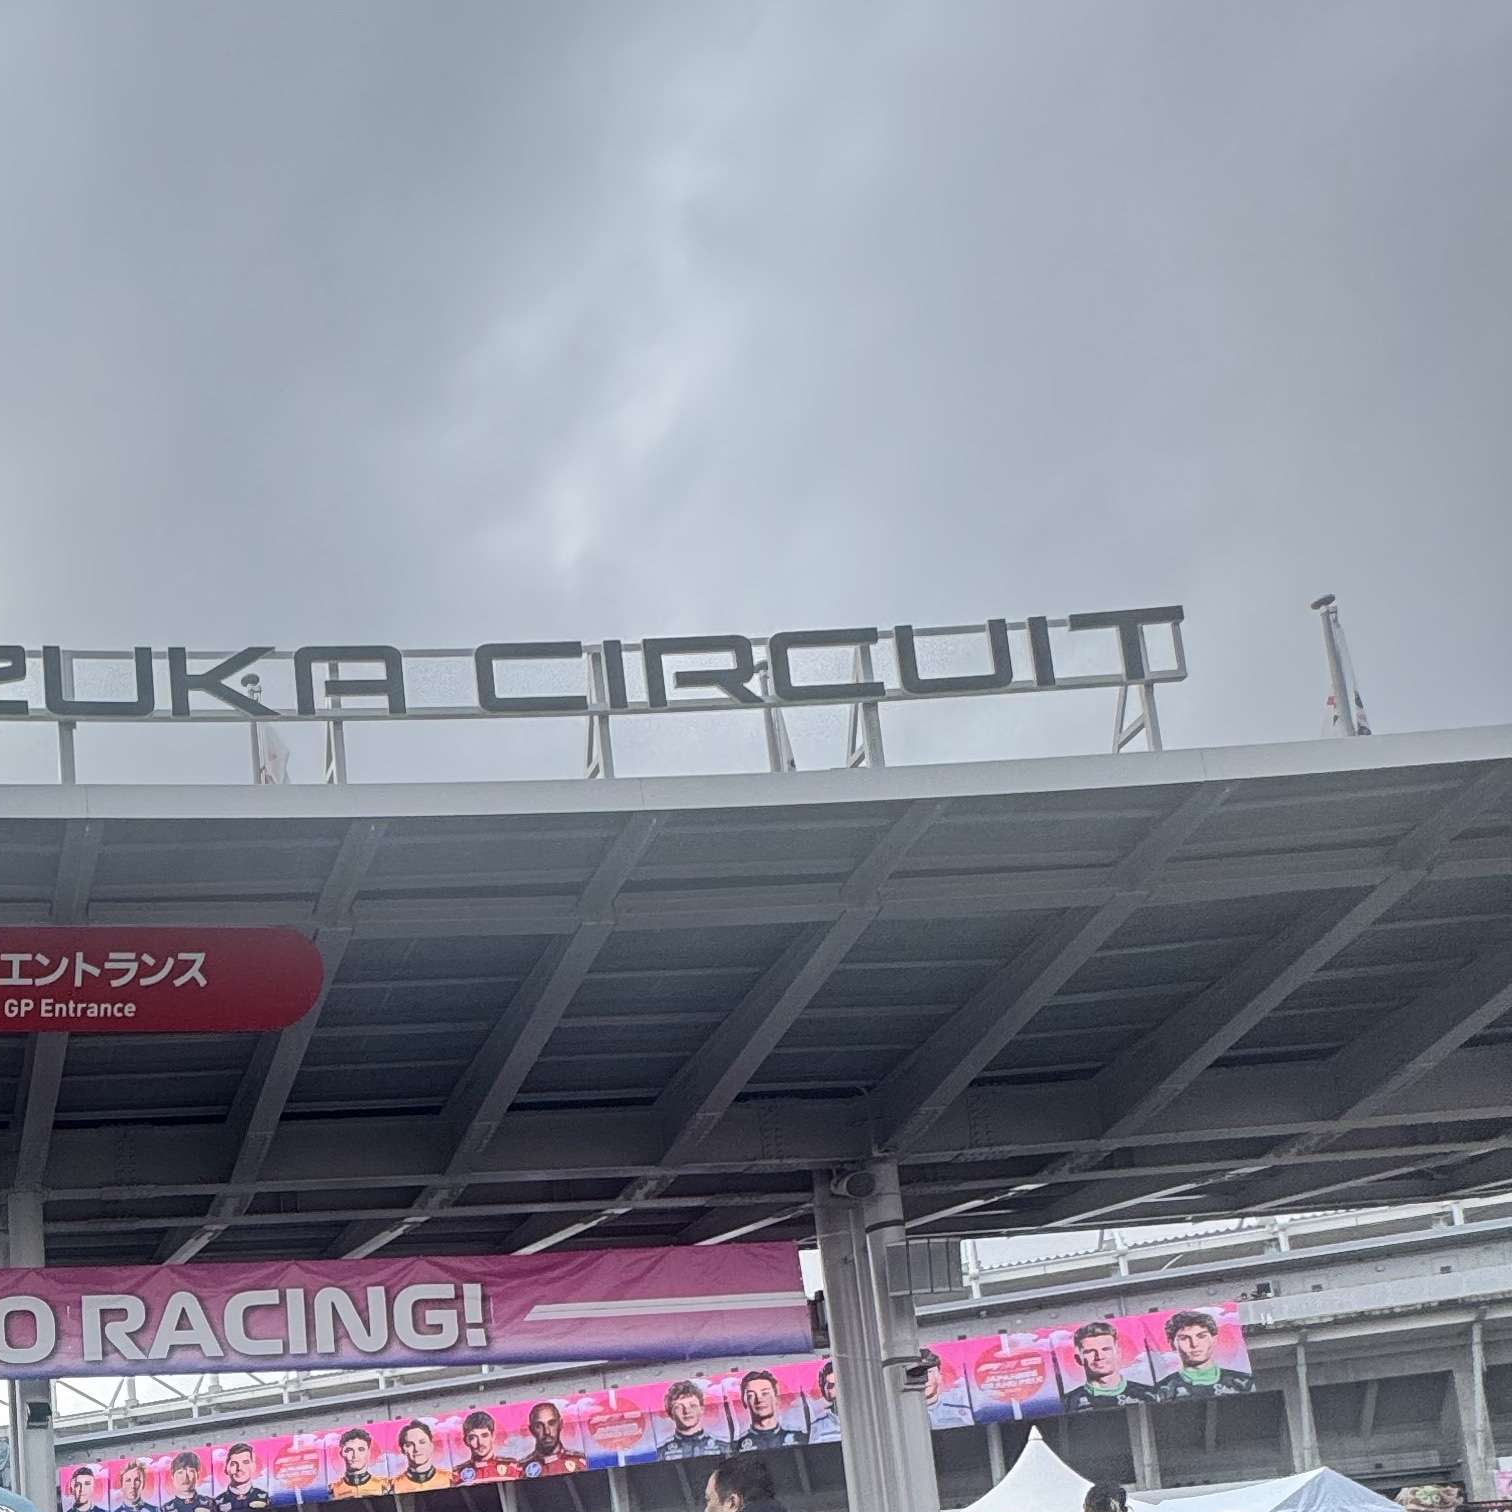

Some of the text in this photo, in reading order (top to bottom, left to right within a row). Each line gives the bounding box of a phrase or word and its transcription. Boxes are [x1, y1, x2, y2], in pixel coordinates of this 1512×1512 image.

[475, 604, 1183, 711] CIRCUIT
[4, 999, 137, 1018] GP Entrance
[81, 1283, 487, 1361] RACING!
